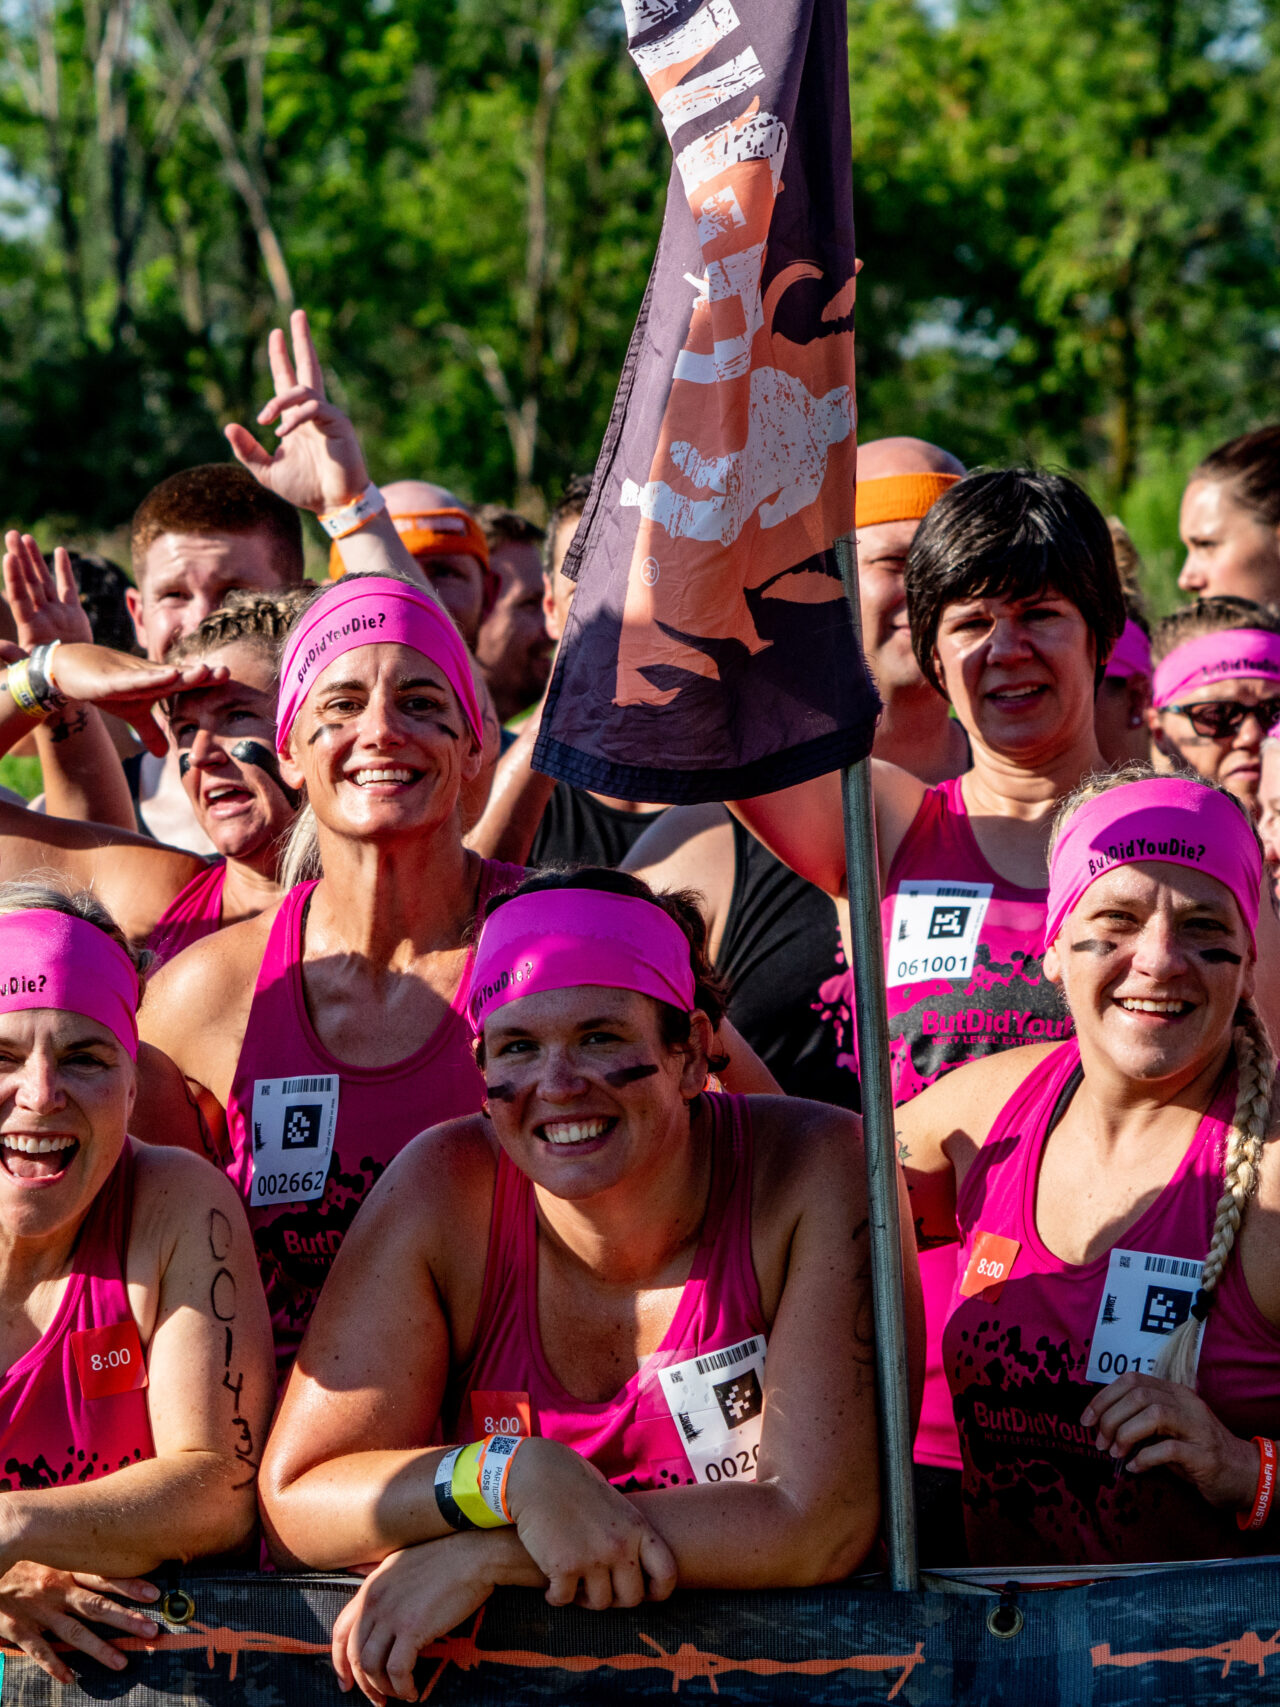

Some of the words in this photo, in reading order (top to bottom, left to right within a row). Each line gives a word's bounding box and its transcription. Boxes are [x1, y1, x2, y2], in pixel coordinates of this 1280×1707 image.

[1088, 837, 1206, 877] ButDidYouDie?
[897, 955, 968, 978] 061001
[931, 1034, 961, 1046] NEXT
[963, 1034, 999, 1045] LEVEL
[257, 1171, 325, 1197] 002662
[976, 1257, 1004, 1279] 8:00
[90, 1348, 131, 1371] 8:00
[484, 1416, 520, 1433] 8:00
[482, 1468, 492, 1491] 2058
[491, 1466, 503, 1514] PARTICIPANT
